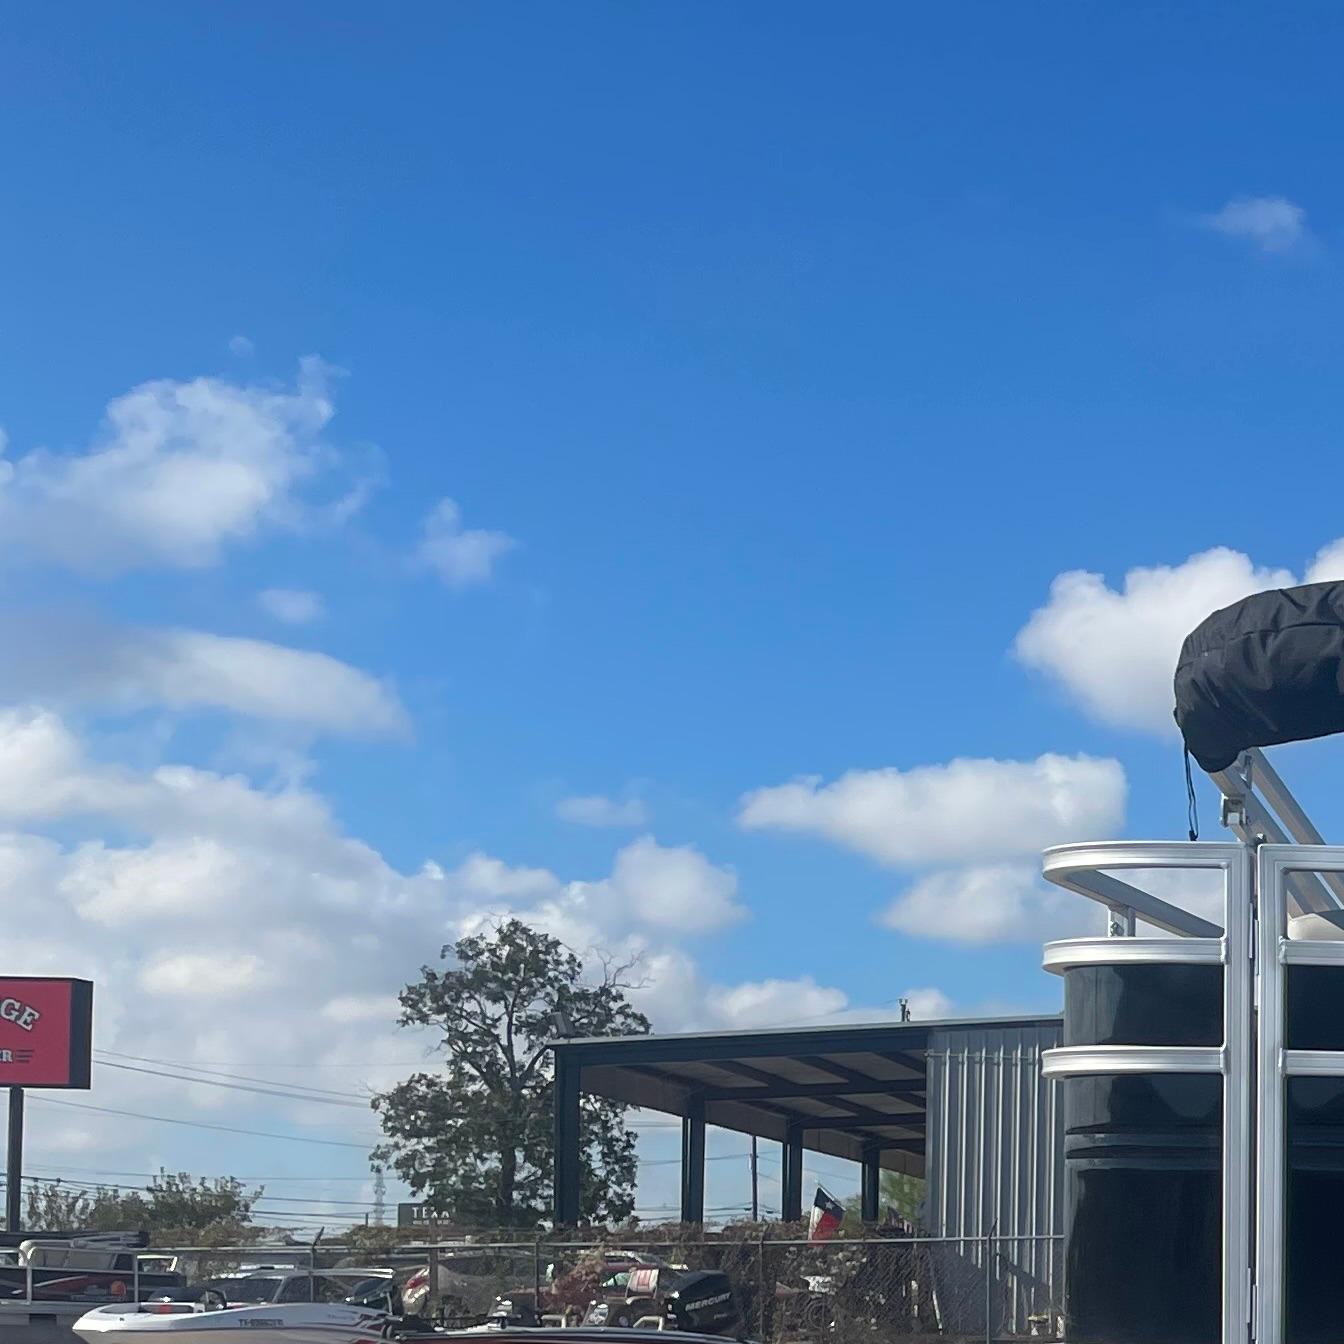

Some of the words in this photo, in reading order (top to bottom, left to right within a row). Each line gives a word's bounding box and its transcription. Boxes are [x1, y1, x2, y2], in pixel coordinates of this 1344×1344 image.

[0, 998, 40, 1032] GE
[0, 1049, 13, 1062] R
[685, 1292, 732, 1311] MERCURY
